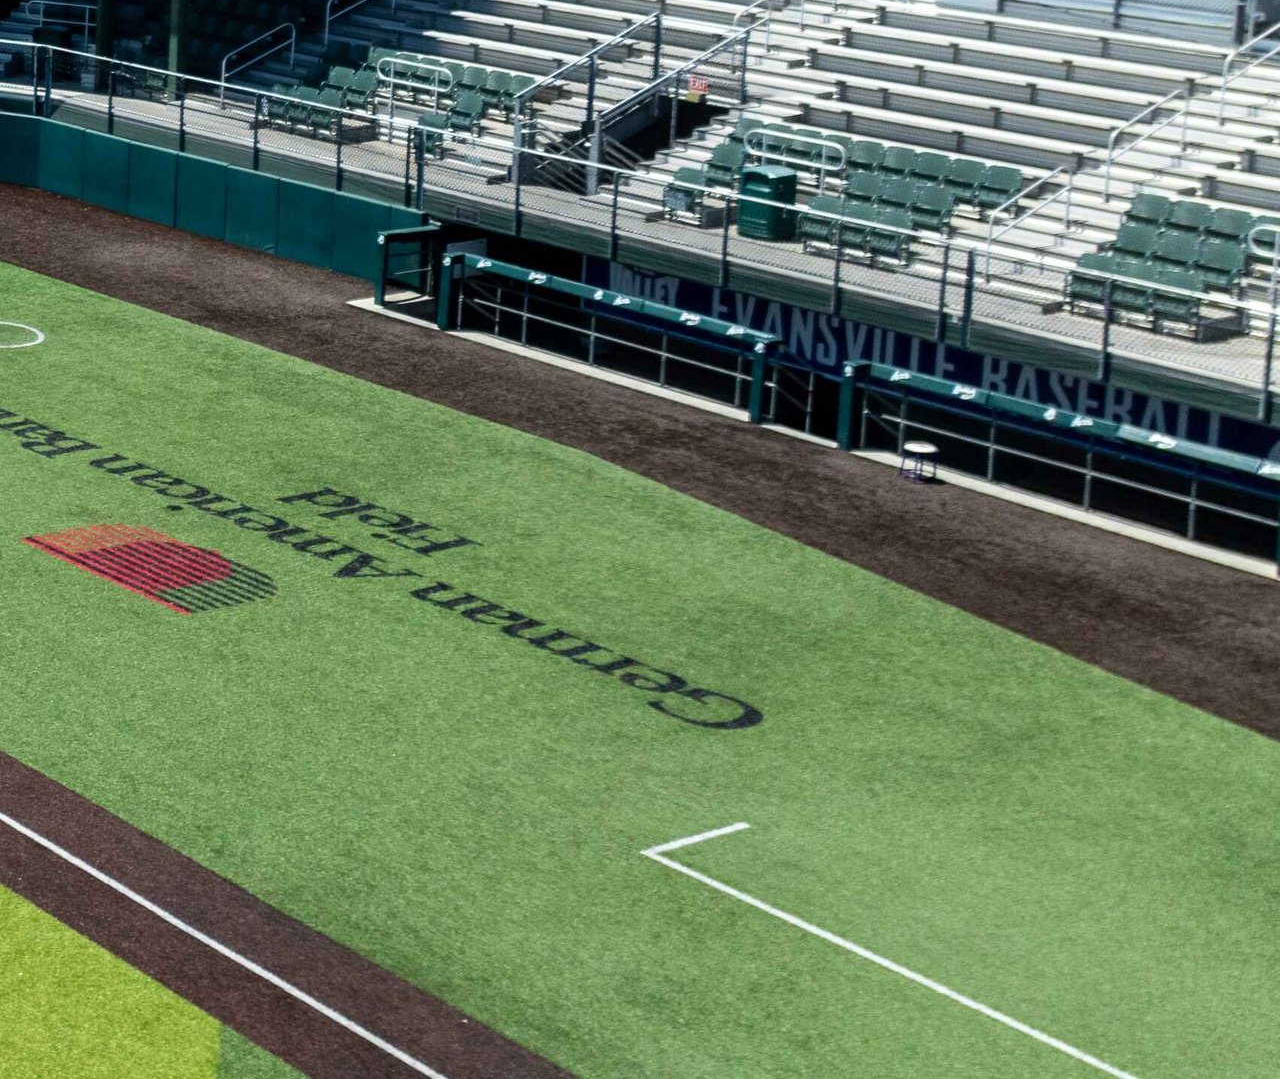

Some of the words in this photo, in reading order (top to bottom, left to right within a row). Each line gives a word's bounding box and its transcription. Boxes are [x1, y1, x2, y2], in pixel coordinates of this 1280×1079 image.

[88, 452, 425, 579] American
[276, 486, 485, 557] Field
[410, 581, 765, 731] German
